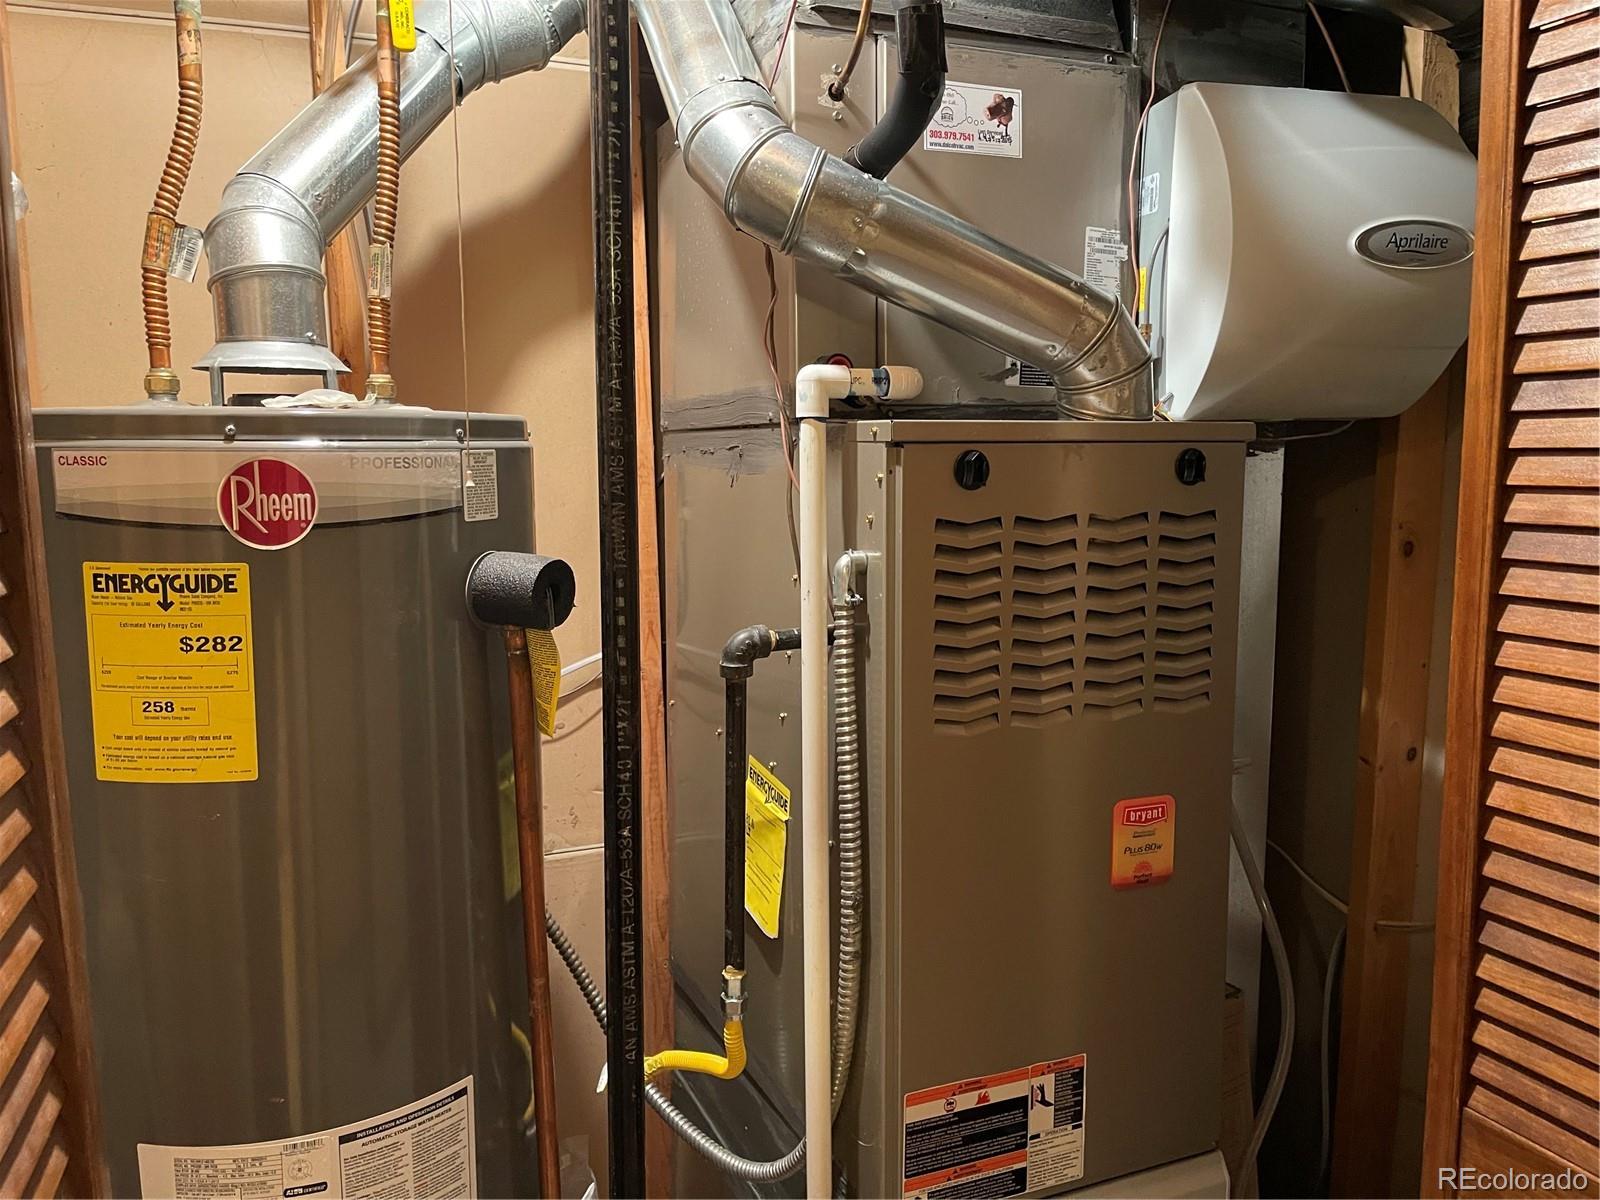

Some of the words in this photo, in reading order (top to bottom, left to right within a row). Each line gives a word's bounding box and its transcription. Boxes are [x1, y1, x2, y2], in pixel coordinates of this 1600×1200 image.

[929, 129, 975, 142] 303.979.7541
[1385, 231, 1449, 253] Aprilaire
[58, 456, 107, 466] CLASSIC
[608, 454, 624, 496] AMS
[230, 461, 312, 534] Rheem
[92, 573, 238, 595] ENERGYGUIDE
[119, 621, 147, 629] Estimated
[147, 621, 166, 630] Yearly
[167, 622, 189, 631] Energy
[189, 622, 203, 630] Cost
[178, 635, 244, 655] $282
[142, 700, 175, 713] 258
[749, 766, 788, 813] ENERGYGUIDE
[1130, 807, 1162, 822] bryant
[621, 941, 636, 990] ASTM
[622, 994, 638, 1031] AMS
[356, 1121, 395, 1139] INSTALLATION
[395, 1116, 408, 1127] AND
[407, 1104, 436, 1121] OPERATION
[361, 1130, 394, 1147] AUTOMATIC
[393, 1123, 417, 1137] STORAGE
[417, 1116, 435, 1127] WATER
